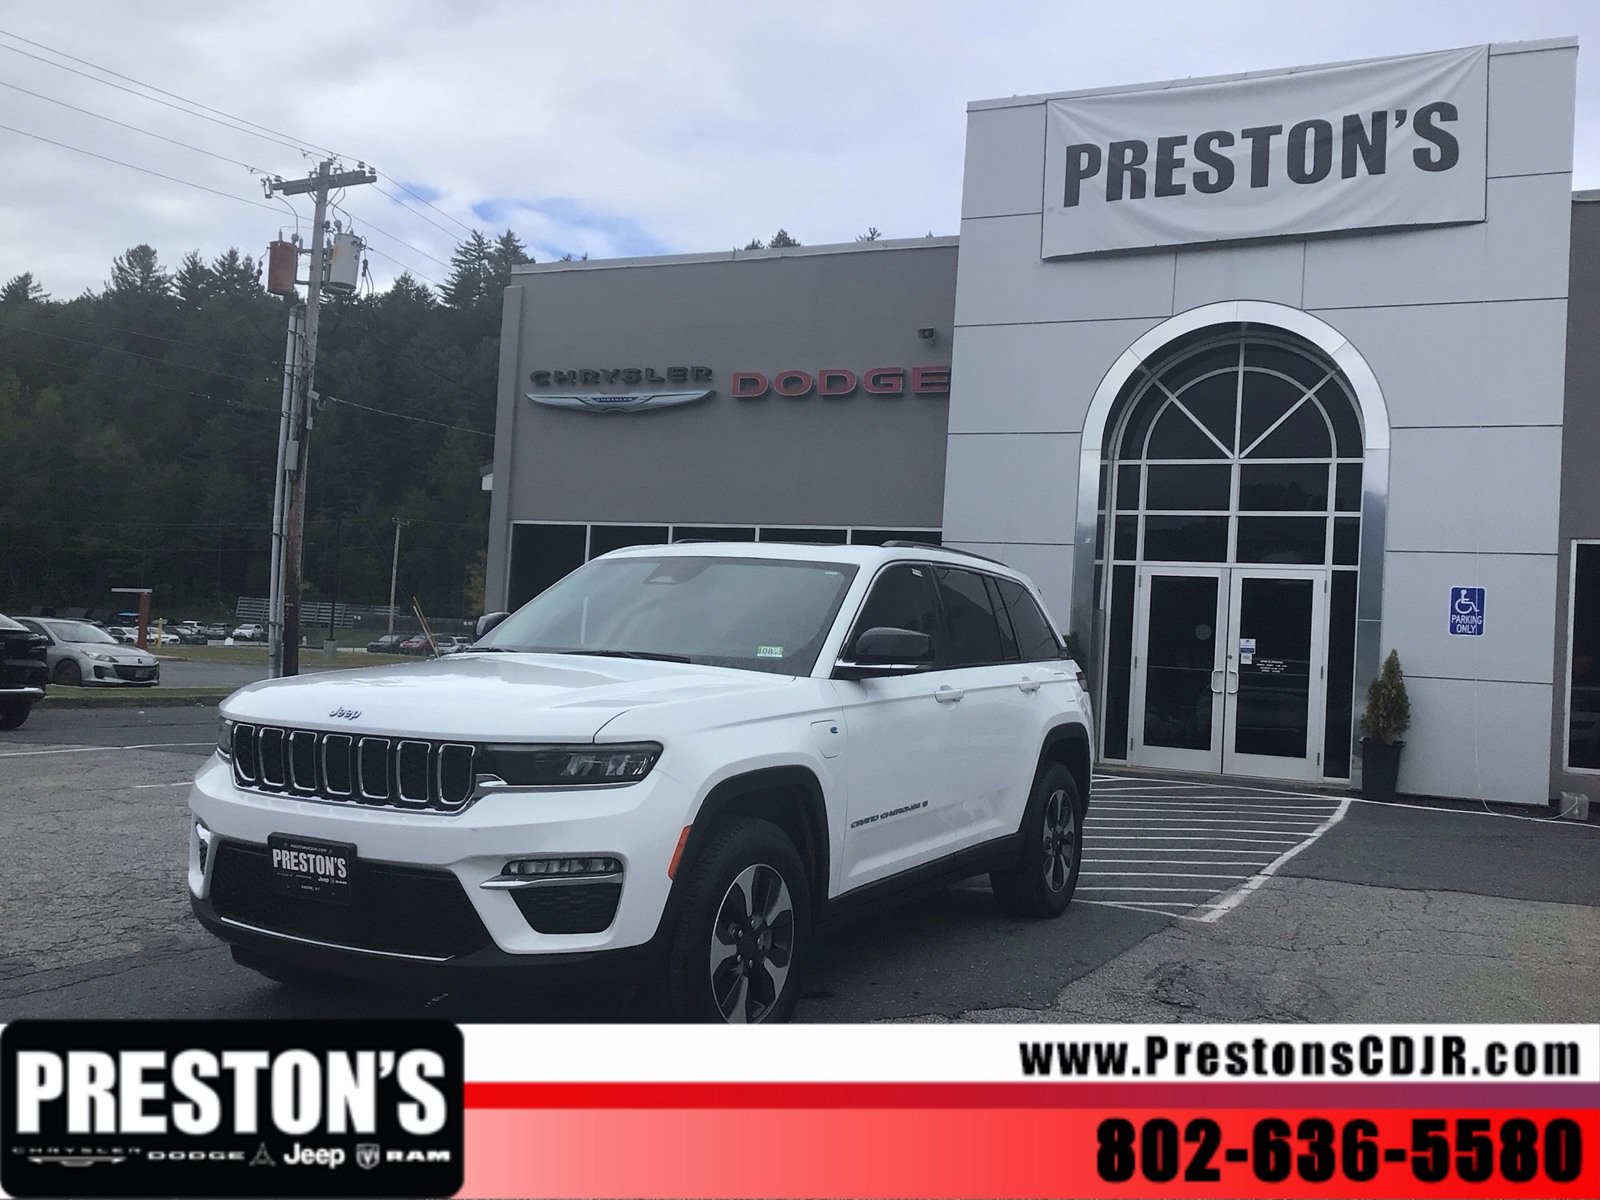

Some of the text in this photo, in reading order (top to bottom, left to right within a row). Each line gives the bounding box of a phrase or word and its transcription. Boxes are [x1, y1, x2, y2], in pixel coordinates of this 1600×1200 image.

[1063, 101, 1460, 208] PRESTON'S
[530, 365, 714, 387] CHRYSLER
[732, 366, 951, 399] DODGE
[1451, 614, 1483, 625] PARKING
[1456, 624, 1477, 635] ONLY
[329, 706, 362, 721] Jeep
[272, 848, 347, 878] PRESTON'S
